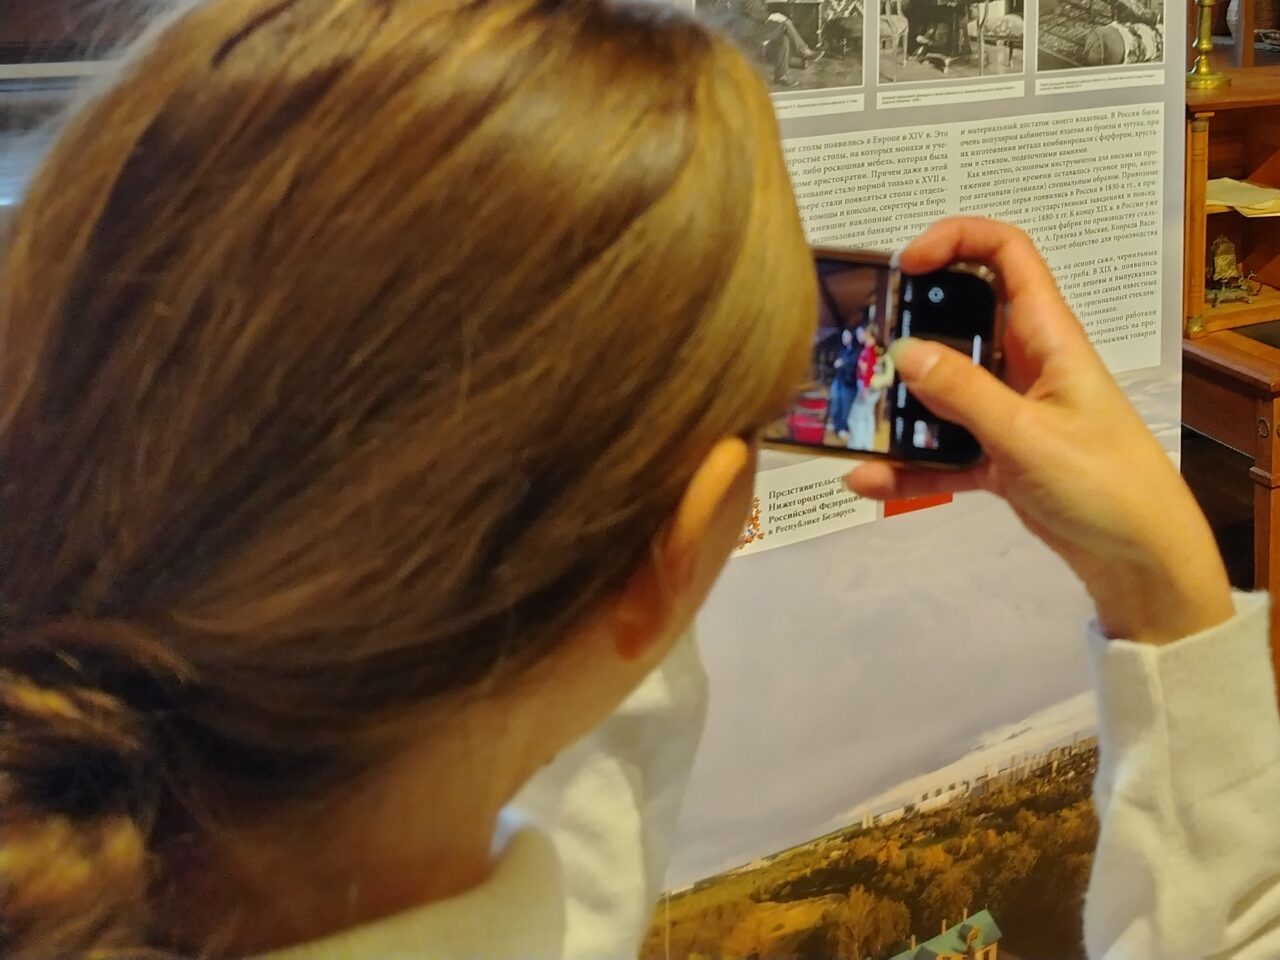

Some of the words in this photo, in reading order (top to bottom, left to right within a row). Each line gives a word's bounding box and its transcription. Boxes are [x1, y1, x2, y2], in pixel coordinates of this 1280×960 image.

[967, 121, 1017, 134] материальный
[1018, 120, 1049, 129] достаток
[1117, 110, 1139, 118] России
[1141, 108, 1159, 116] были
[1019, 130, 1058, 139] кабинетные
[1093, 123, 1116, 132] бронзы
[1146, 119, 1159, 127] при
[797, 144, 822, 152] столы
[823, 139, 865, 149] появились
[872, 135, 900, 145] Европе
[908, 130, 924, 139] XIV
[934, 129, 948, 137] Это
[970, 145, 1016, 155] изготовлении
[1042, 136, 1093, 147] комбинировали
[1098, 131, 1133, 142] фарфором,
[822, 153, 848, 161] столы,
[860, 147, 893, 156] которых
[894, 144, 924, 152] монахи
[980, 157, 1010, 165] стеклом,
[1011, 151, 1057, 161] поделочными
[801, 165, 822, 175] либо
[823, 162, 865, 174] роскошная
[896, 155, 927, 164] которая
[928, 152, 948, 160] была
[870, 169, 901, 179] Причем
[902, 167, 922, 175] даже
[929, 162, 947, 171] этой
[966, 170, 980, 178] Как
[981, 167, 1013, 176] известно,
[1014, 163, 1049, 171] основным
[1050, 157, 1096, 167] инструментом
[1110, 152, 1132, 160] письма
[834, 186, 855, 194] стало
[856, 180, 885, 192] нормой
[887, 179, 913, 187] только
[921, 173, 939, 183] XVII
[959, 181, 990, 190] тяжении
[992, 177, 1020, 186] долгого
[1022, 173, 1051, 183] времени
[1053, 168, 1091, 177] оставалось
[1092, 164, 1118, 174] гусиное
[1119, 162, 1137, 170] перо,
[959, 194, 972, 203] рое
[973, 189, 1011, 198] затачивали
[1012, 181, 1046, 195] (очиняли)
[1048, 178, 1091, 188] специальным
[1121, 169, 1158, 180] Привозные
[820, 199, 842, 207] стали
[844, 193, 887, 204] появляться
[888, 190, 912, 198] столы
[918, 187, 947, 195] отдель-
[959, 200, 1010, 211] металлические
[1032, 192, 1068, 201] появились
[1075, 187, 1097, 195] России
[1031, 199, 1087, 212] государственных
[1089, 194, 1124, 203] заведениях
[809, 212, 838, 221] комоды
[879, 201, 918, 211] секретеры
[1075, 208, 1094, 216] концу
[1095, 204, 1108, 213] XIX
[1121, 201, 1143, 209] России
[1145, 200, 1158, 208] уже
[810, 222, 846, 232] имевшие
[848, 215, 892, 226] наклонные
[894, 208, 947, 220] столешницы,
[866, 225, 901, 235] банкиры
[1057, 220, 1082, 231] фабрик
[1092, 212, 1136, 225] производству
[1110, 222, 1137, 231] Конрада
[1068, 238, 1099, 248] общество
[1100, 236, 1111, 244] для
[1113, 229, 1157, 242] производства
[1073, 260, 1095, 268] основе
[1099, 265, 1112, 274] XIX
[1121, 259, 1157, 270] появились
[1063, 282, 1080, 290] были
[1081, 278, 1106, 288] дешевы
[1114, 269, 1157, 281] выпускались
[1069, 290, 1091, 299] Одним
[1101, 285, 1121, 293] самых
[1122, 279, 1157, 289] известных
[1083, 294, 1127, 308] оригинальных
[1095, 315, 1123, 327] успешно
[1125, 309, 1156, 321] работали
[1129, 329, 1156, 339] товаров
[768, 478, 842, 499] Представительст
[768, 490, 835, 511] Нижегородской
[768, 506, 817, 524] Российской
[775, 518, 820, 533] Республике
[822, 507, 856, 521] Беларусь
